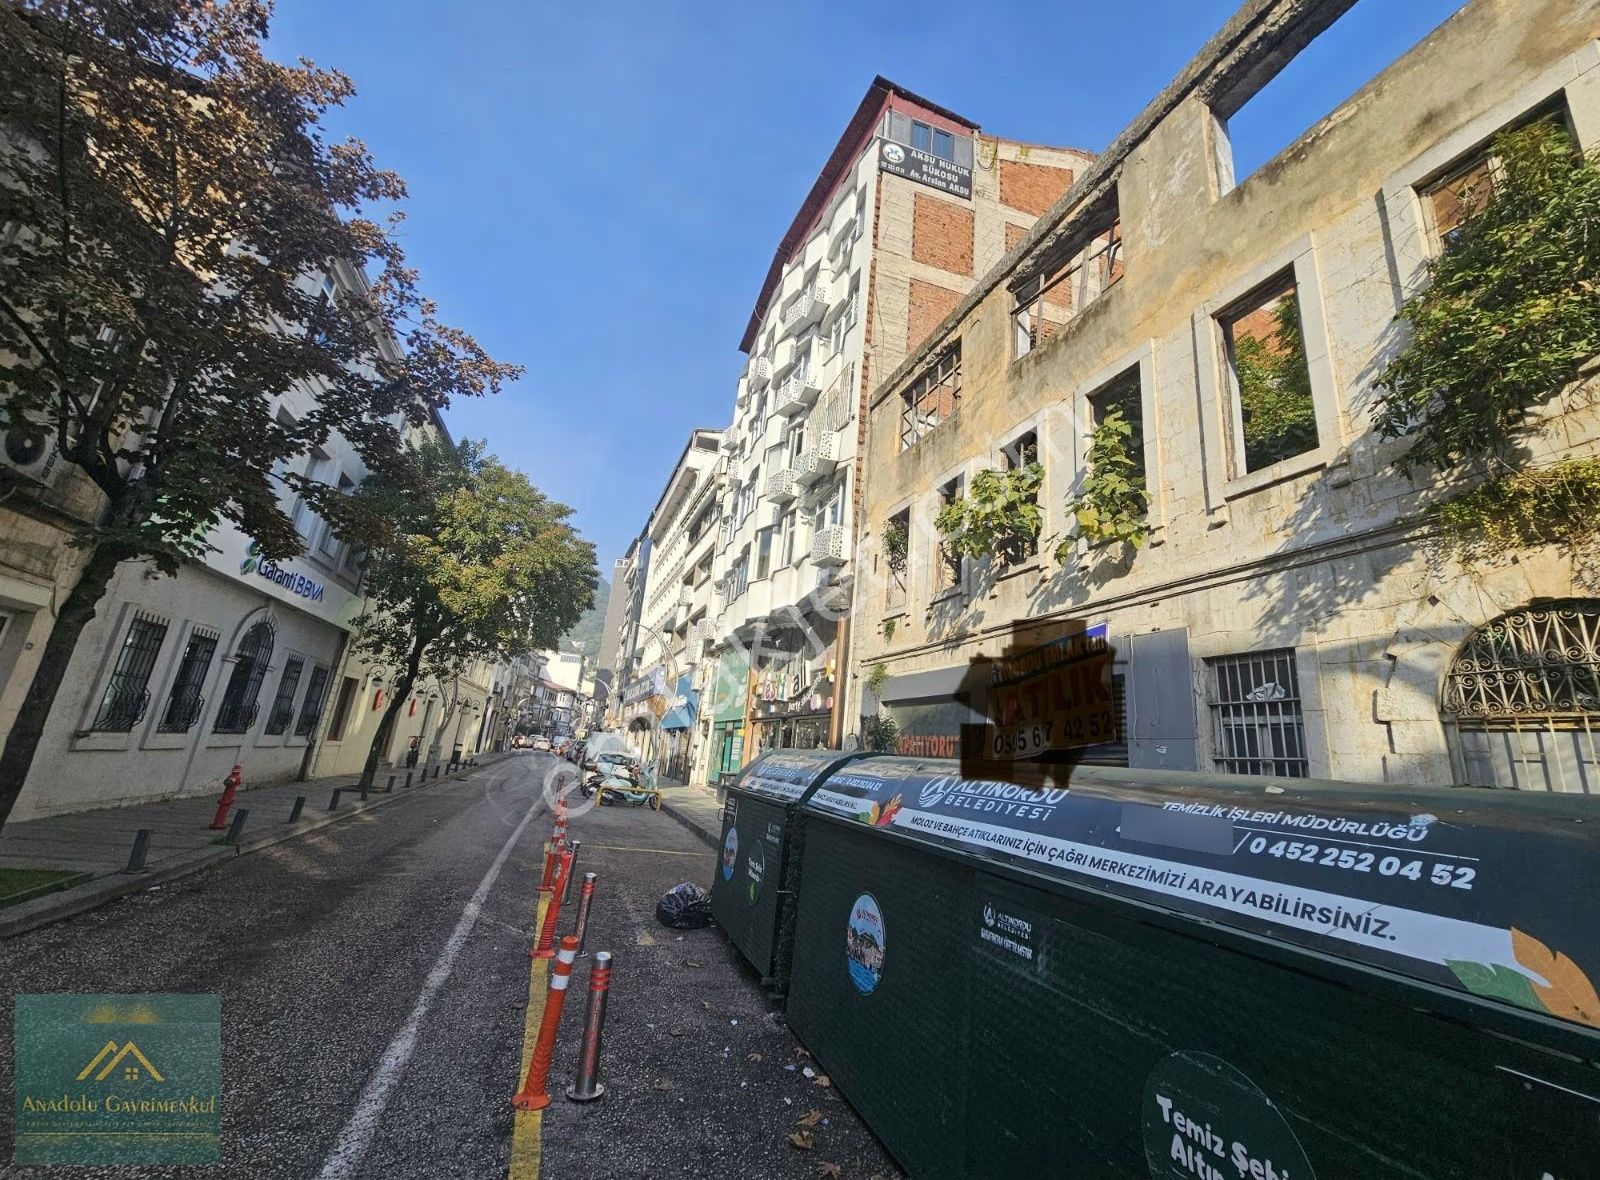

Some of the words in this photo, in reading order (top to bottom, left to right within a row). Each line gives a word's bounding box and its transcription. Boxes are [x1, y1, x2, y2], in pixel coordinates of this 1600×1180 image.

[911, 150, 935, 164] AKSU
[939, 160, 970, 177] HUKUK
[922, 164, 958, 182] BÜROSU
[949, 184, 970, 196] AKSU
[259, 555, 298, 591] Garanti
[953, 780, 1070, 805] ALTINORDU
[1162, 801, 1228, 818] TEMİZLİK
[1227, 808, 1284, 825] İŞLERİ
[1281, 814, 1428, 841] MÜDÜRLÜĞÜ
[911, 816, 934, 831] MOLOZ
[933, 823, 944, 833] VE
[943, 824, 968, 838] BAHÇE
[969, 828, 1024, 850] ATIKLARINIZ
[1023, 838, 1047, 858] İÇİN
[1047, 848, 1088, 867] ÇAĞRI
[1087, 855, 1187, 889] MERKEZİMİZİ
[1187, 878, 1397, 941] ARAYABİLİRSİNİZ.
[1268, 840, 1316, 861] 452
[1318, 848, 1375, 873] 252
[1378, 857, 1422, 881] 04
[1431, 866, 1477, 890] 52
[1156, 1094, 1225, 1158] Temiz
